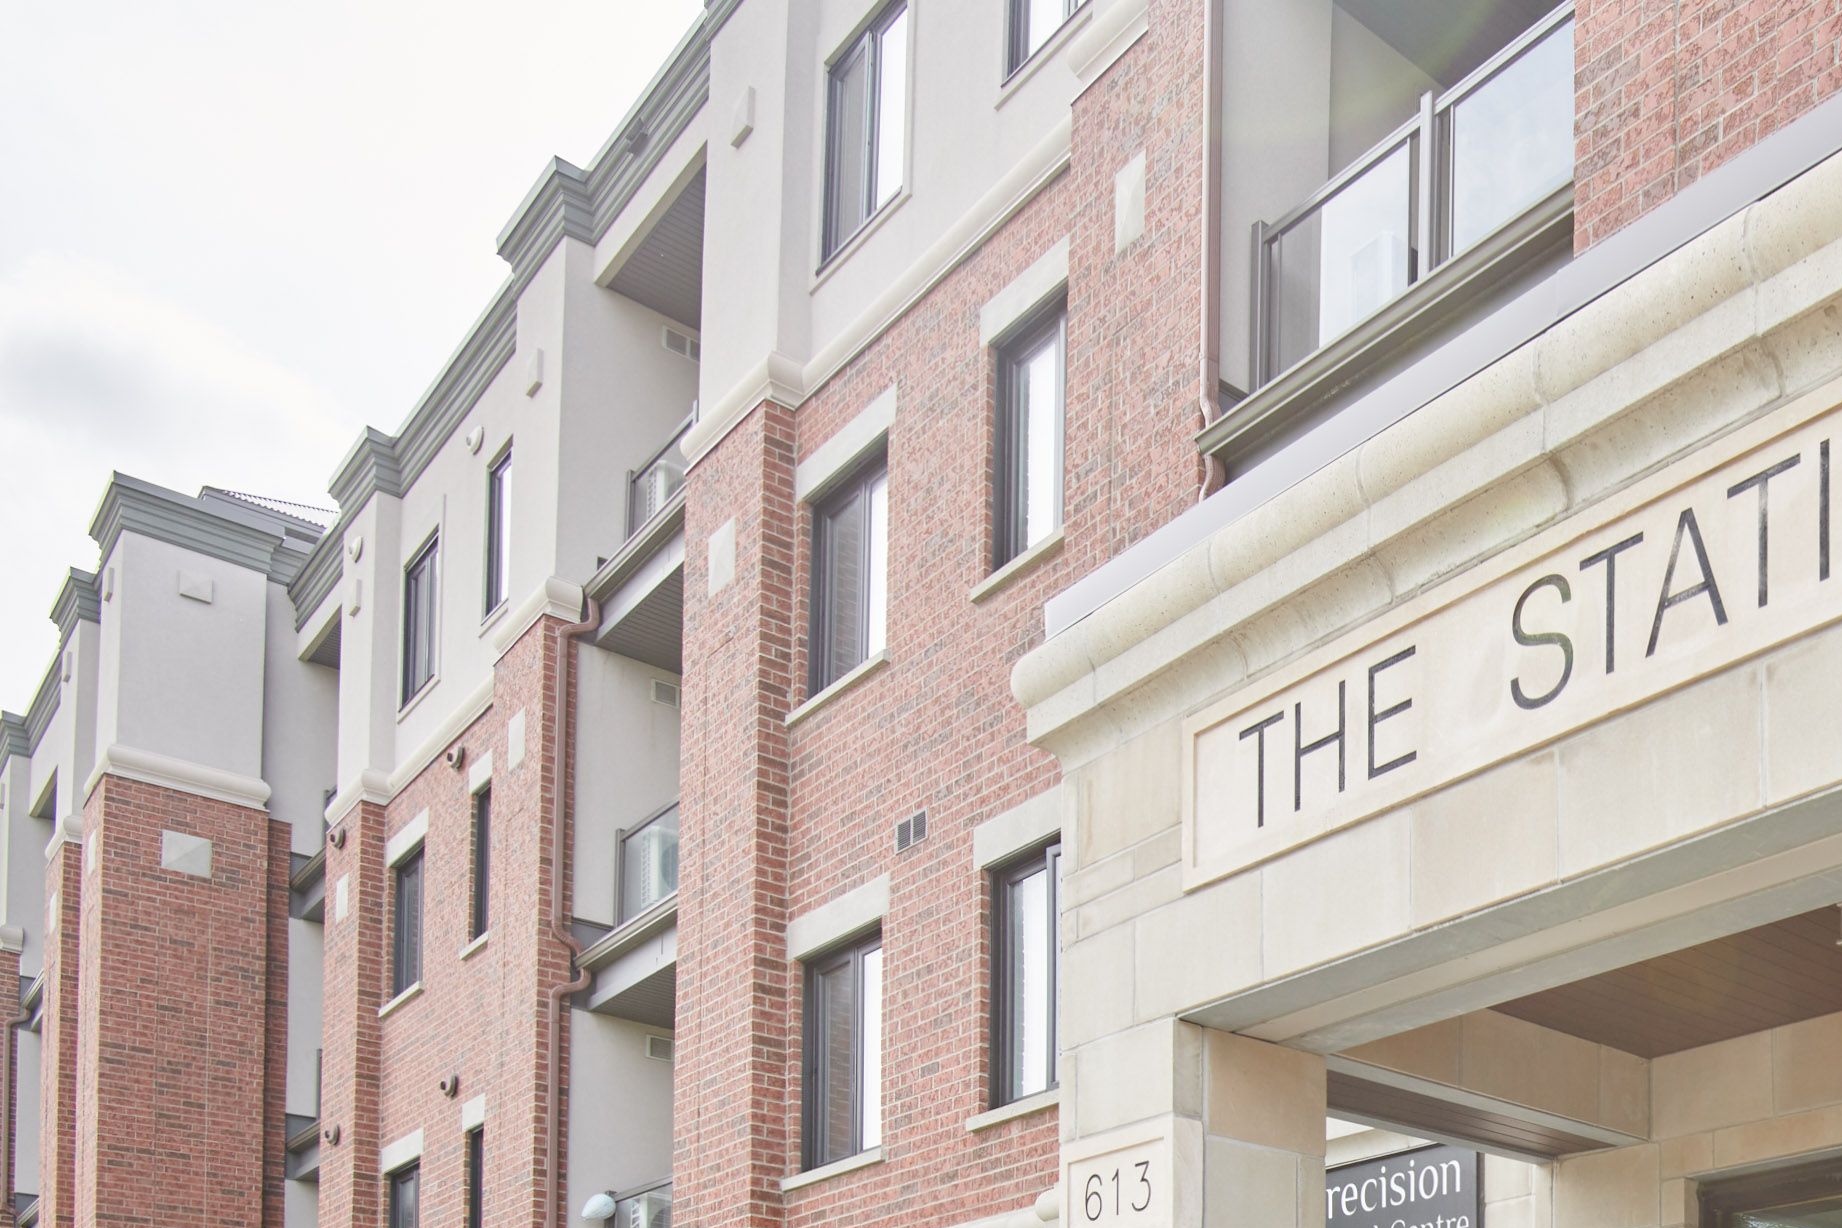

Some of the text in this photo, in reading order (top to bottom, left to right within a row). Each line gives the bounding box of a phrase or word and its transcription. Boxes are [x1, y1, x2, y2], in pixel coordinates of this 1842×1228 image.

[1239, 645, 1417, 828] THE
[1085, 1160, 1151, 1221] 613
[1326, 1159, 1461, 1220] recision
